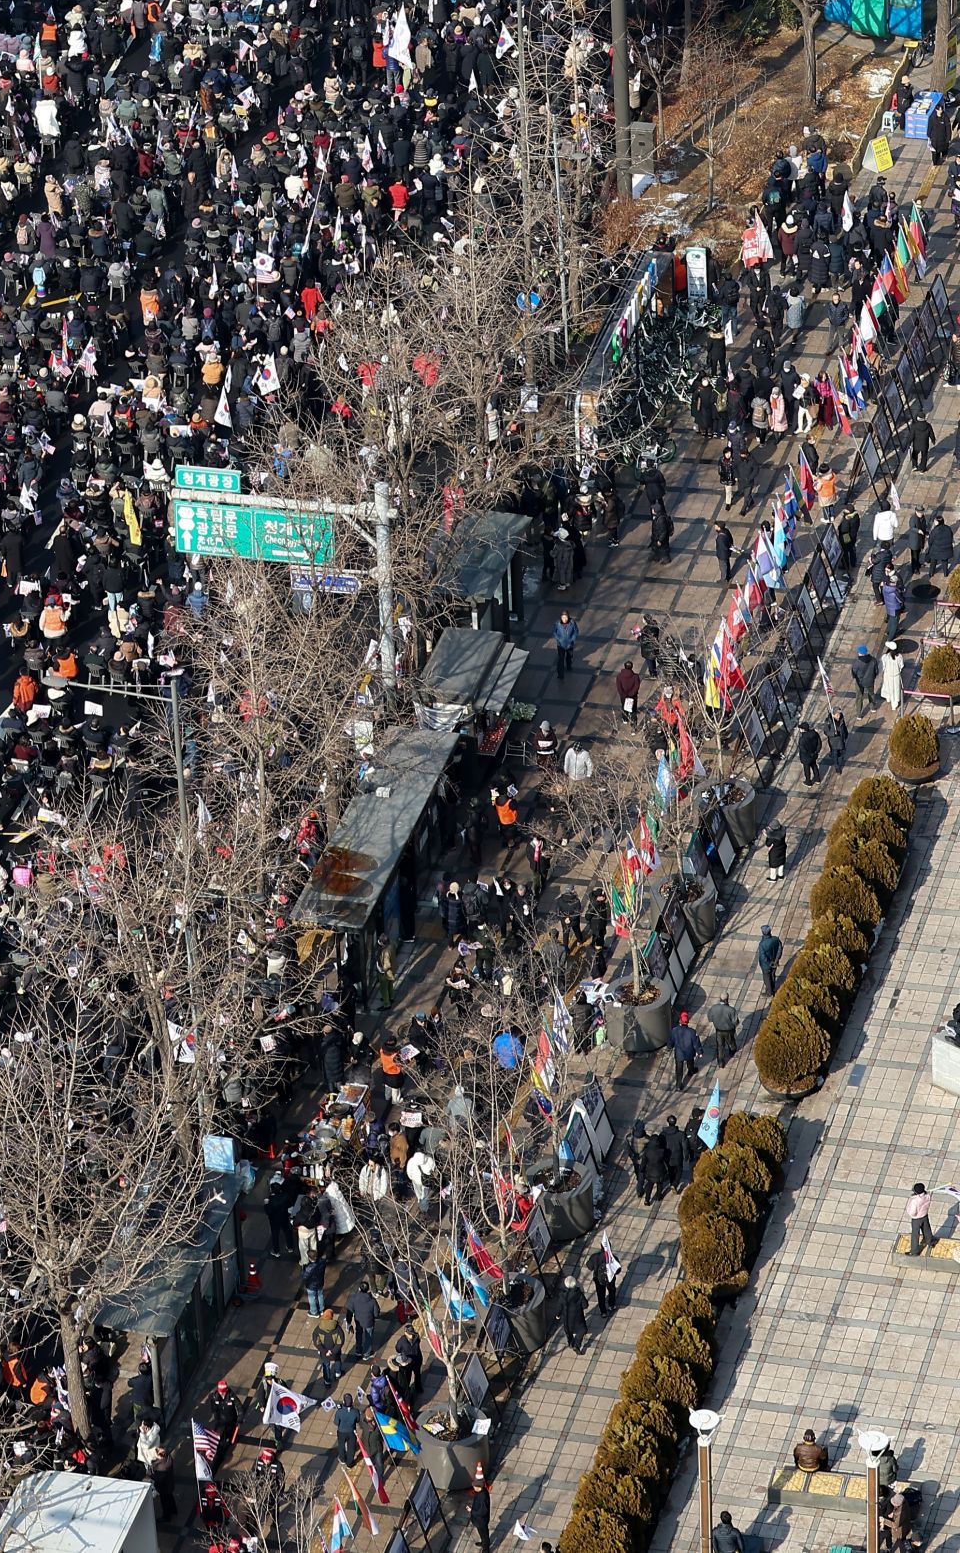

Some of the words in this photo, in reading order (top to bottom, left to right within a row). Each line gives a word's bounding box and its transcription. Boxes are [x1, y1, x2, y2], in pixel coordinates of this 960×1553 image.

[182, 472, 234, 489] 청계광장
[196, 507, 238, 525] 독립문
[196, 522, 238, 539] 광화문
